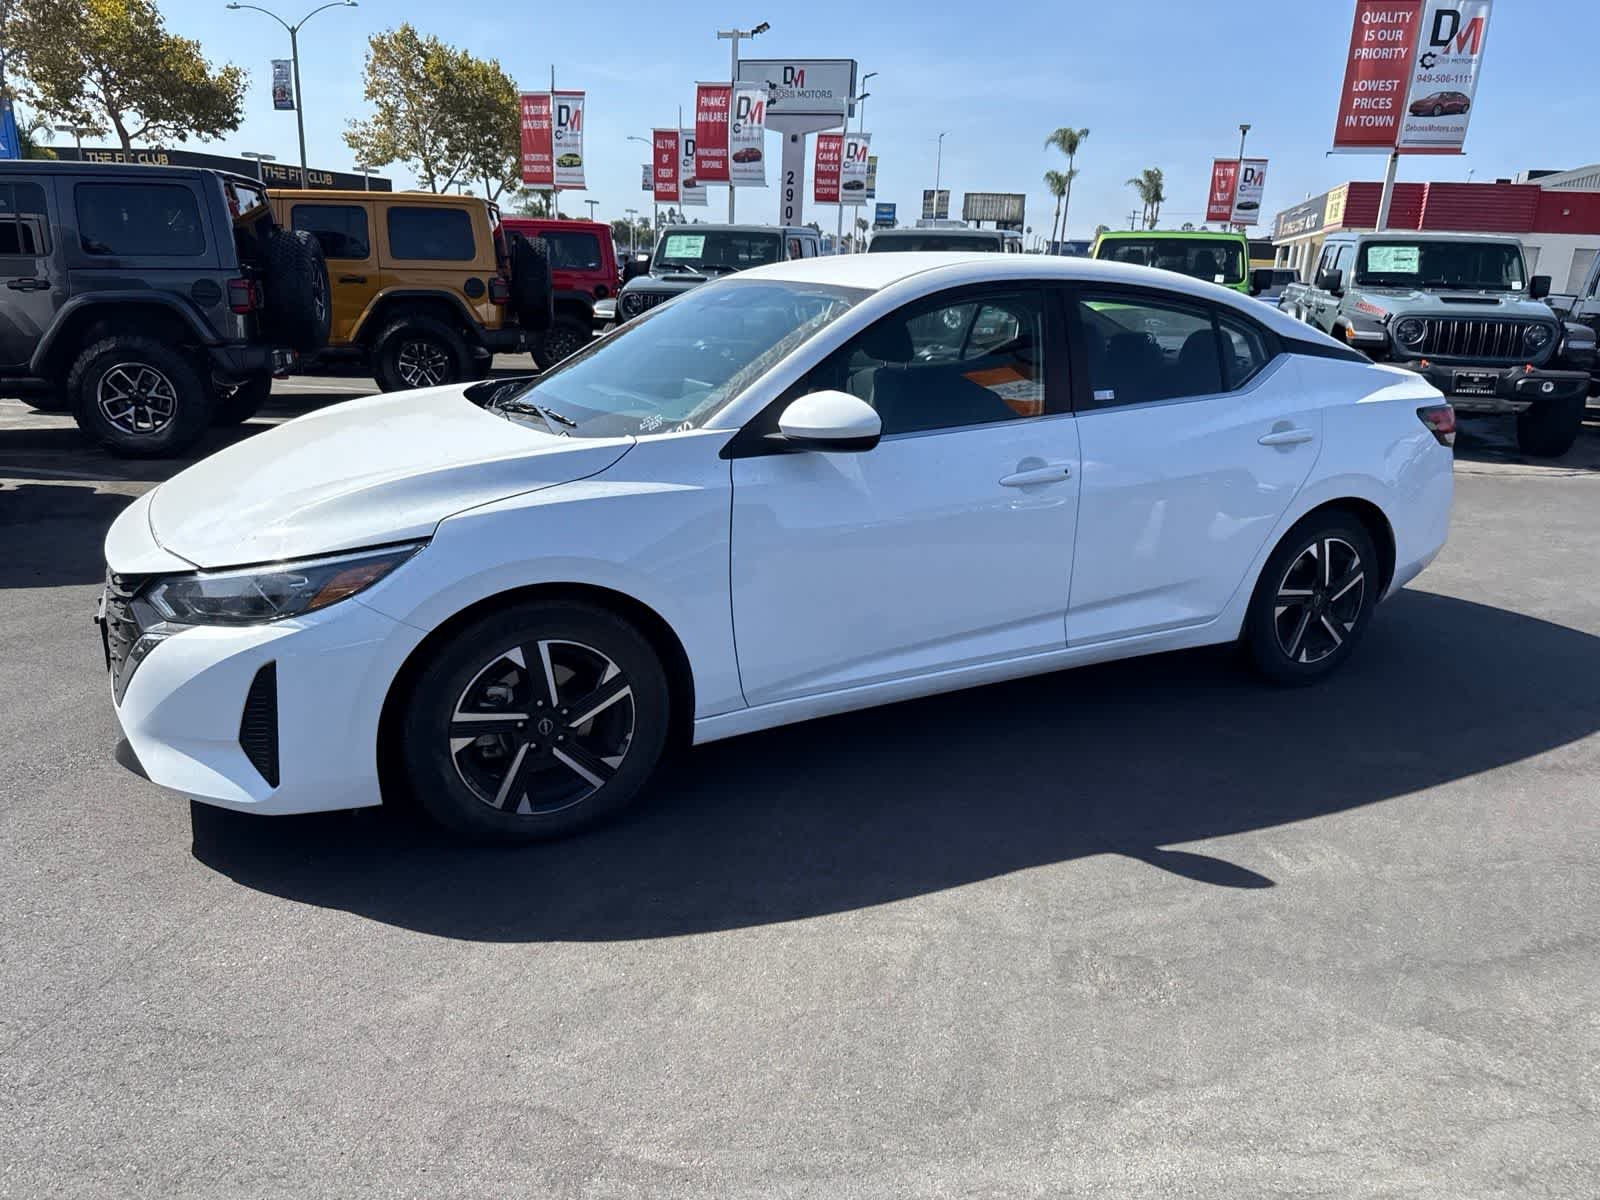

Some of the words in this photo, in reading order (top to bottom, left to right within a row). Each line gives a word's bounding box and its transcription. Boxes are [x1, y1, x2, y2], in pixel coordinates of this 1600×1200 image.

[1361, 11, 1413, 24] QUALITY
[1364, 30, 1375, 42] IS
[1377, 30, 1404, 42] OUR
[1429, 9, 1485, 56] DM
[1354, 47, 1409, 60] PRIORITY
[783, 65, 805, 89] DM
[1352, 80, 1400, 92] LOWEST
[700, 96, 727, 107] FINANCE
[1352, 97, 1393, 110] PRICES
[697, 111, 728, 123] AVAILABLE
[736, 96, 764, 125] DM
[557, 104, 582, 132] DM
[1345, 116, 1358, 127] IN
[1359, 115, 1395, 128] TOWN
[86, 151, 112, 164] THE
[115, 152, 135, 165] FI
[138, 152, 169, 166] CLUB
[846, 142, 867, 163] DM
[262, 164, 287, 180] THE
[307, 171, 334, 186] CLUB
[785, 170, 795, 226] 290
